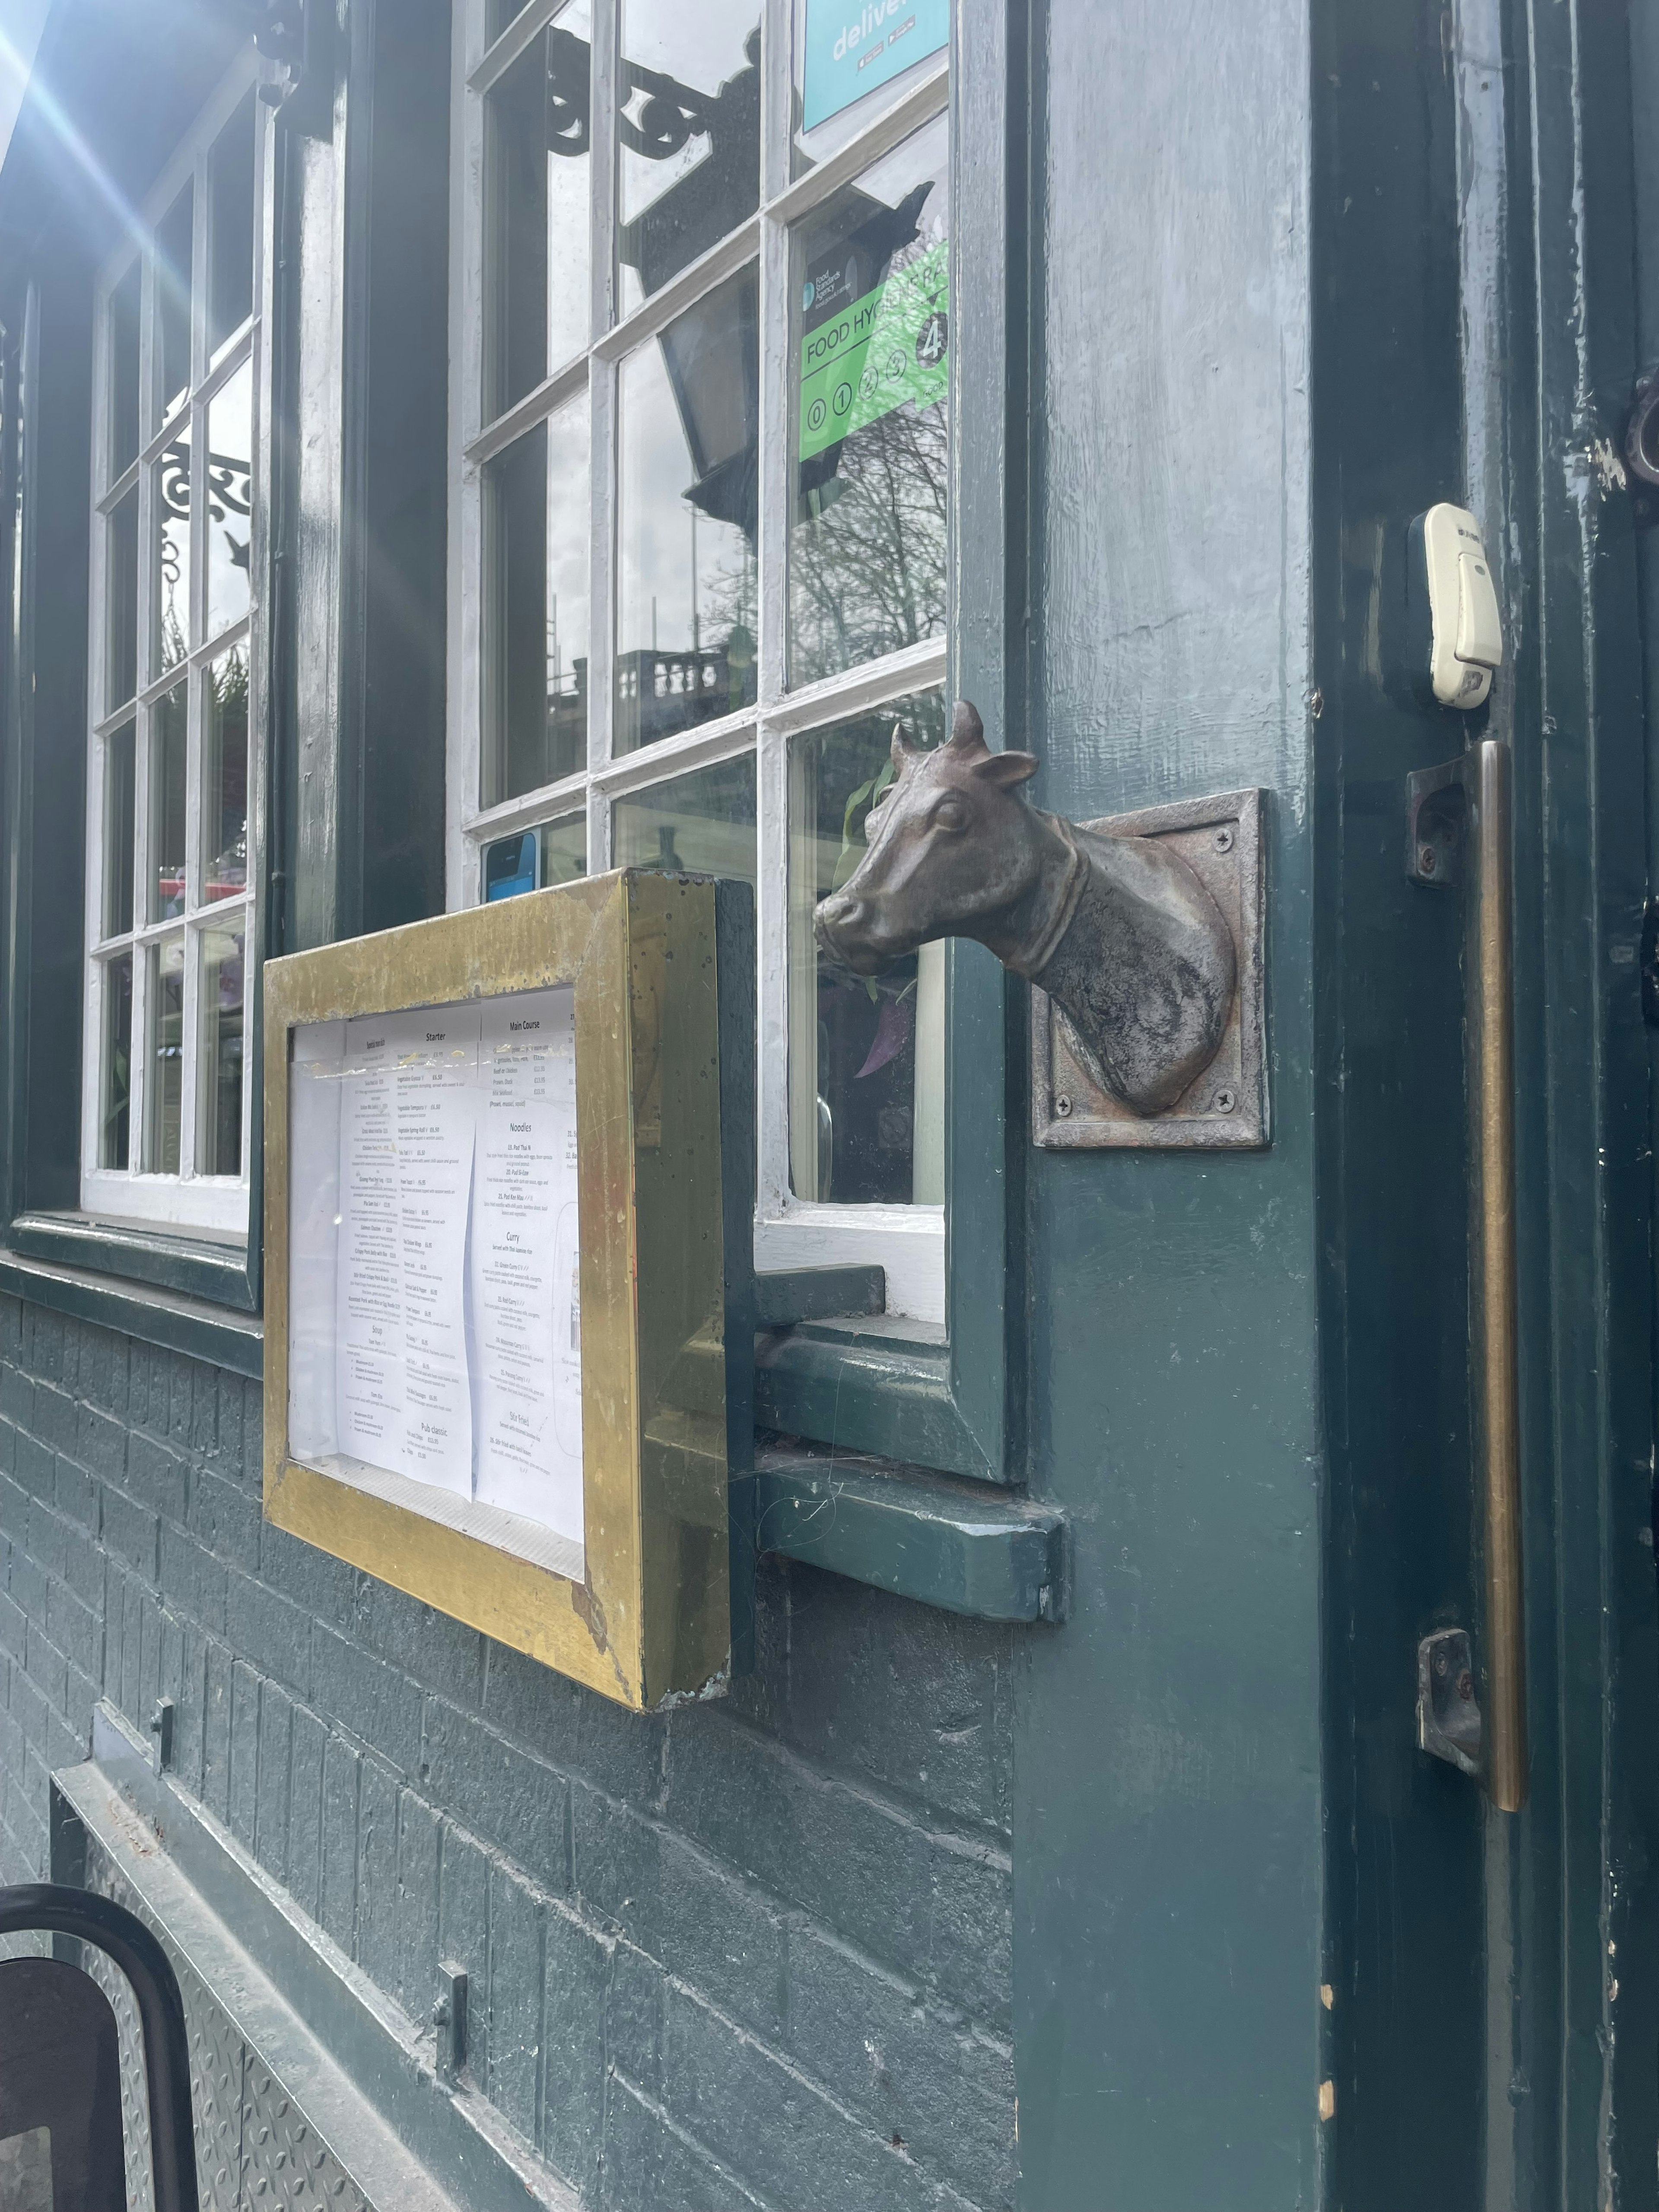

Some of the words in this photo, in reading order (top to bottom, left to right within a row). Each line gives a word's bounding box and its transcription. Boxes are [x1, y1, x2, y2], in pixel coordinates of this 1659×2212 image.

[833, 0, 906, 60] delive
[816, 270, 829, 283] Food
[816, 271, 840, 290] Standards
[816, 283, 835, 301] Agency
[807, 322, 849, 364] FOOD
[924, 320, 941, 359] 4
[510, 1021, 522, 1031] Main
[523, 1020, 540, 1030] Course
[426, 1033, 445, 1041] Starter
[510, 1123, 531, 1132] Noodles
[506, 1231, 519, 1244] Curry
[372, 1325, 382, 1336] Soup
[518, 1414, 529, 1426] Fried
[422, 1422, 430, 1433] Pub
[432, 1425, 448, 1437] classic
